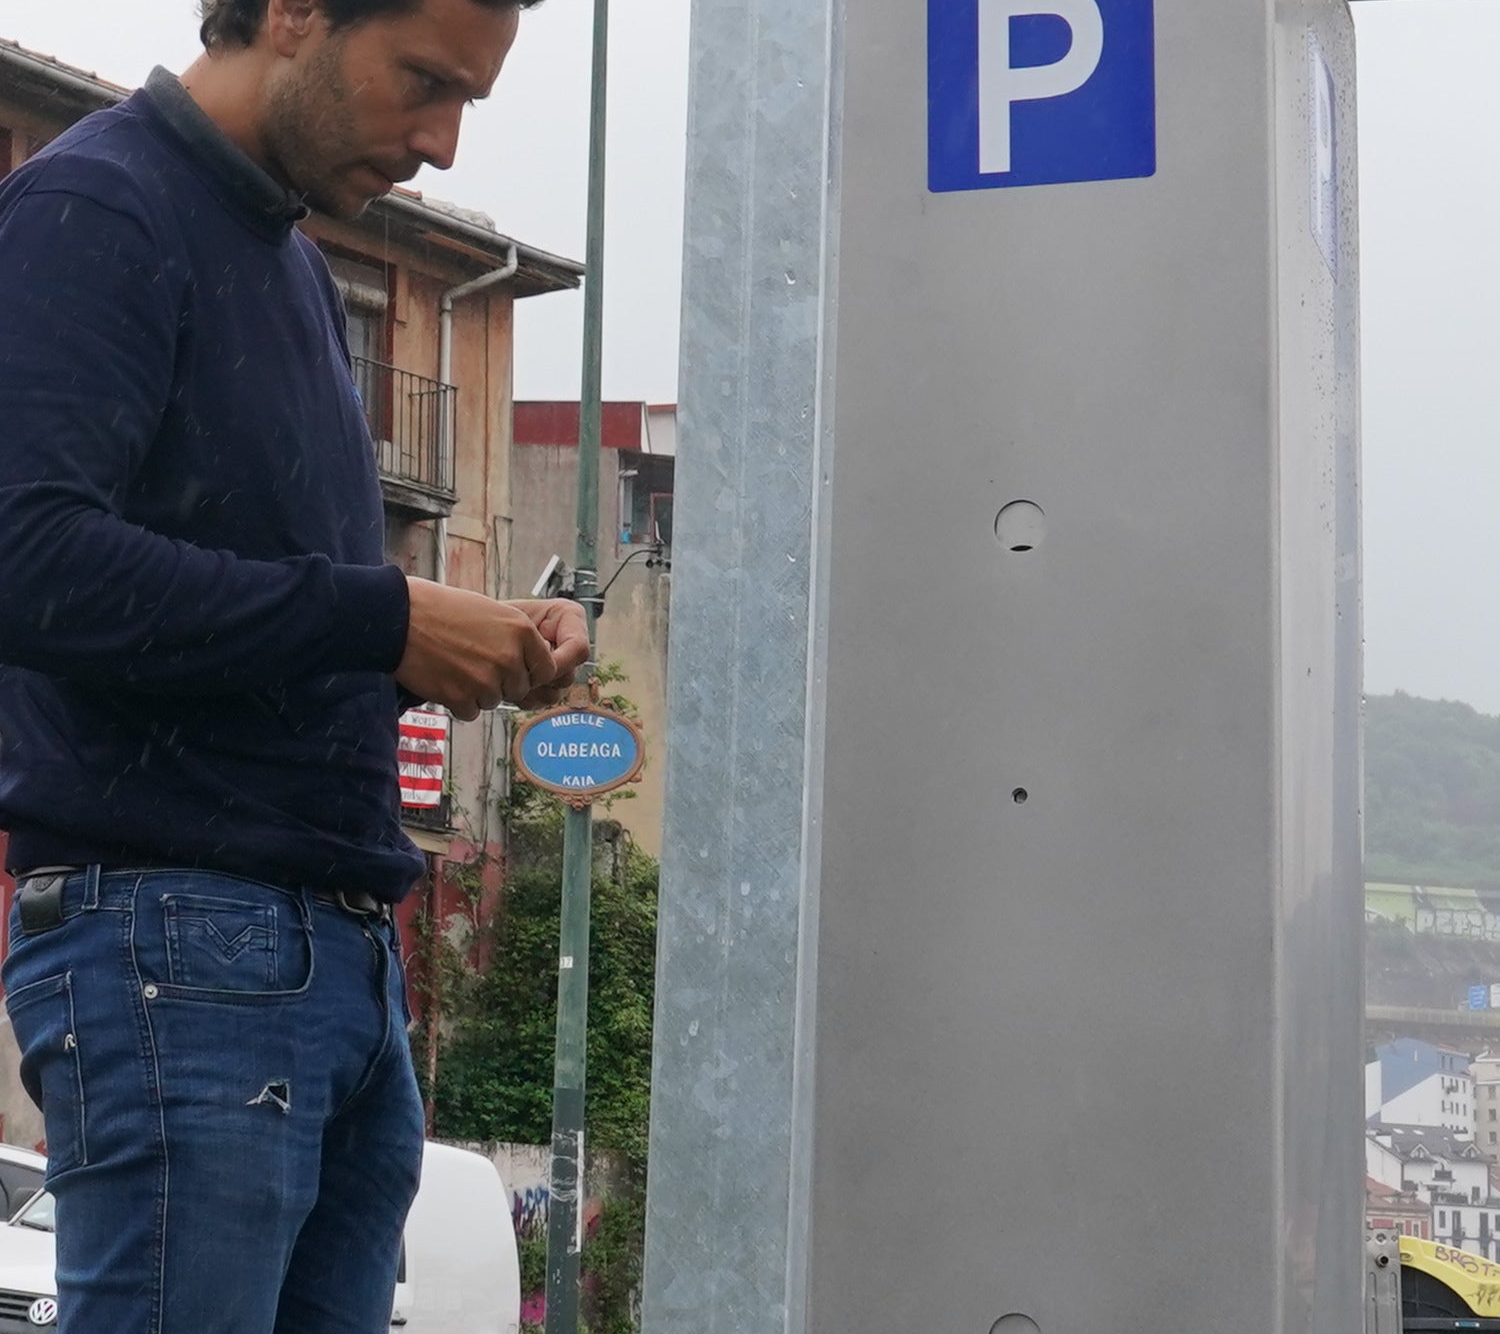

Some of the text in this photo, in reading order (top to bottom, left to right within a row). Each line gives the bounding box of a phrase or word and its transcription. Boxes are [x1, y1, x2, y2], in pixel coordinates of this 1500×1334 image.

[551, 713, 606, 728] MUELLE
[537, 742, 621, 757] OLABEAGA
[562, 775, 596, 786] KAIA
